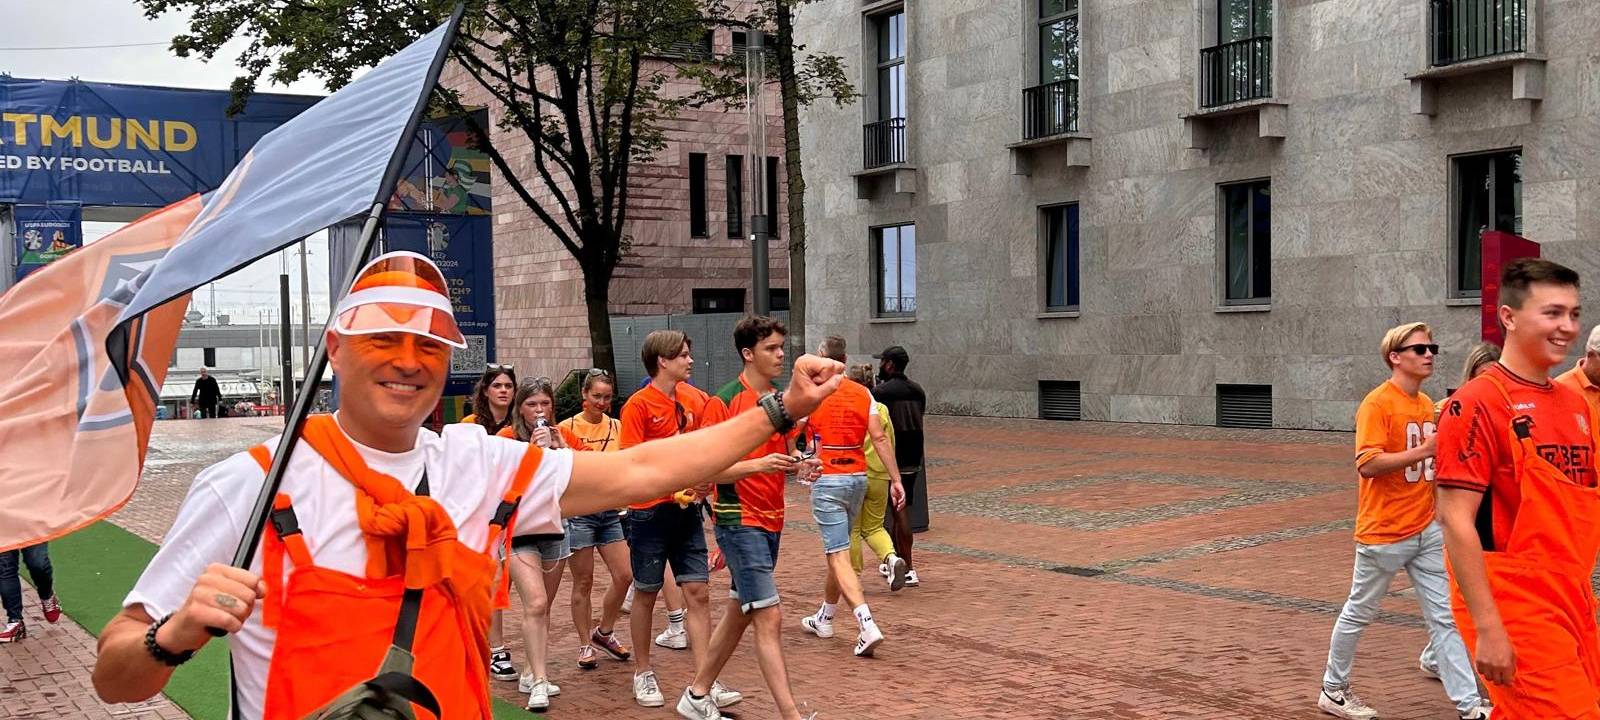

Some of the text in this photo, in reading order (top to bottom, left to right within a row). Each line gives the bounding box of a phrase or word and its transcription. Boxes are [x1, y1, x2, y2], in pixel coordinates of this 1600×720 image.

[0, 112, 198, 152] TMUND
[26, 155, 57, 170] BY
[60, 157, 171, 174] FOOTBALL
[451, 278, 464, 286] TO
[1559, 444, 1590, 466] BET
